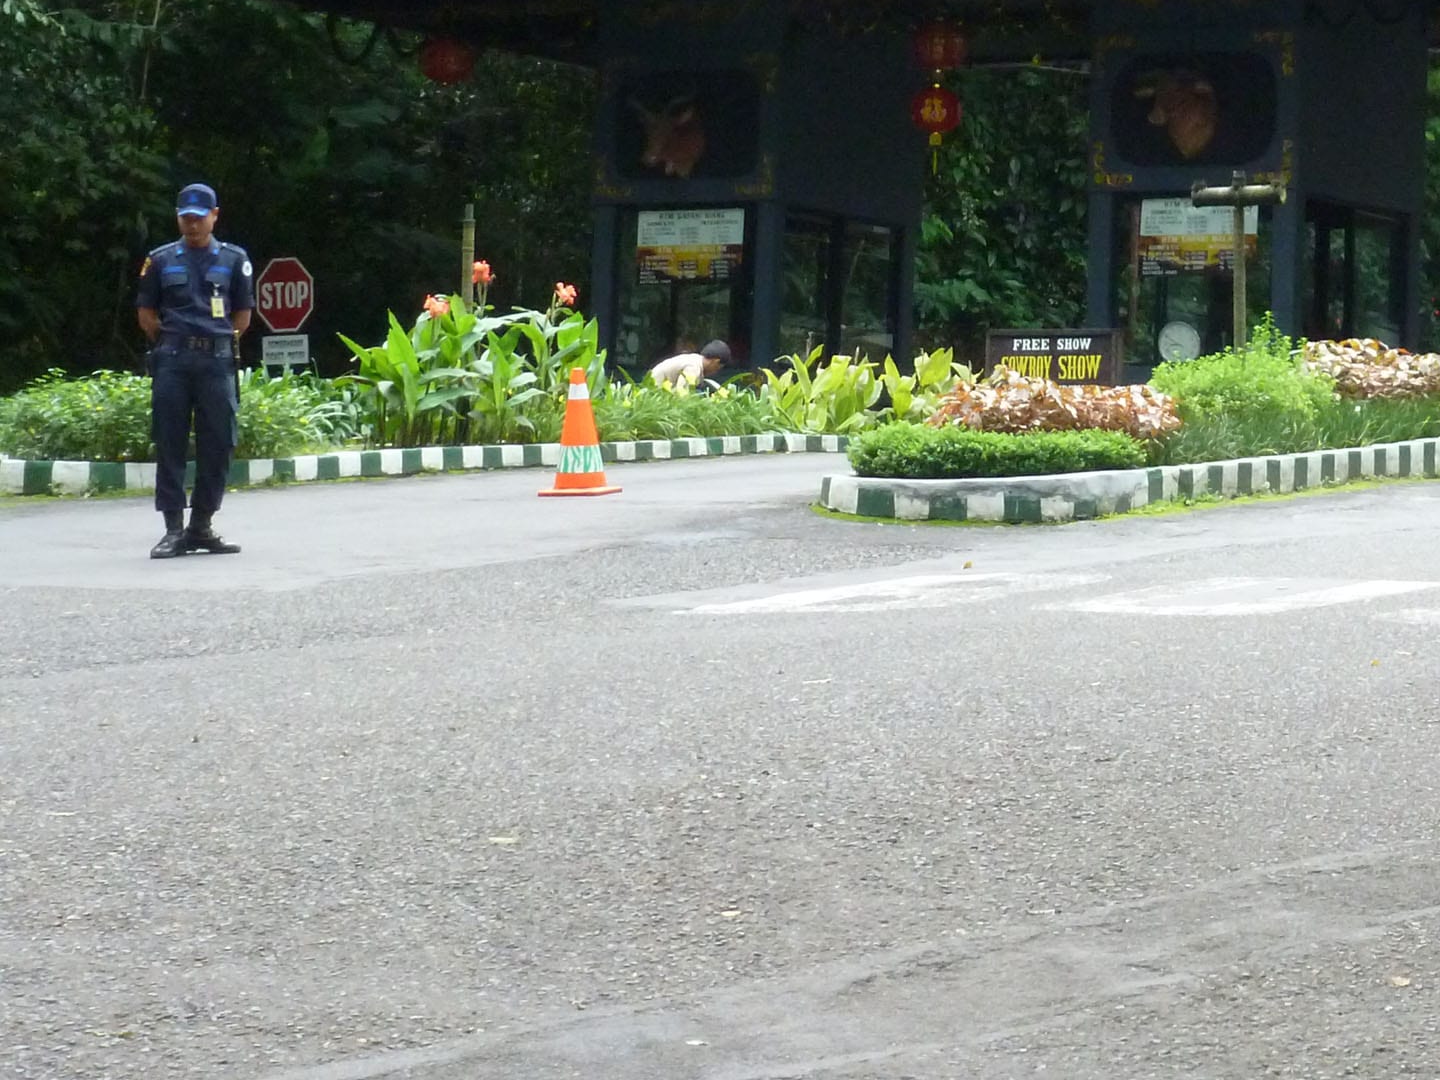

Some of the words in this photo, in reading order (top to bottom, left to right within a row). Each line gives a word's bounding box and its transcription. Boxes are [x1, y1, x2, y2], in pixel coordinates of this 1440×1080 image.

[261, 281, 309, 310] STOP
[1012, 338, 1050, 351] FREE
[1057, 338, 1092, 351] SHOW
[1058, 354, 1102, 380] SHOW
